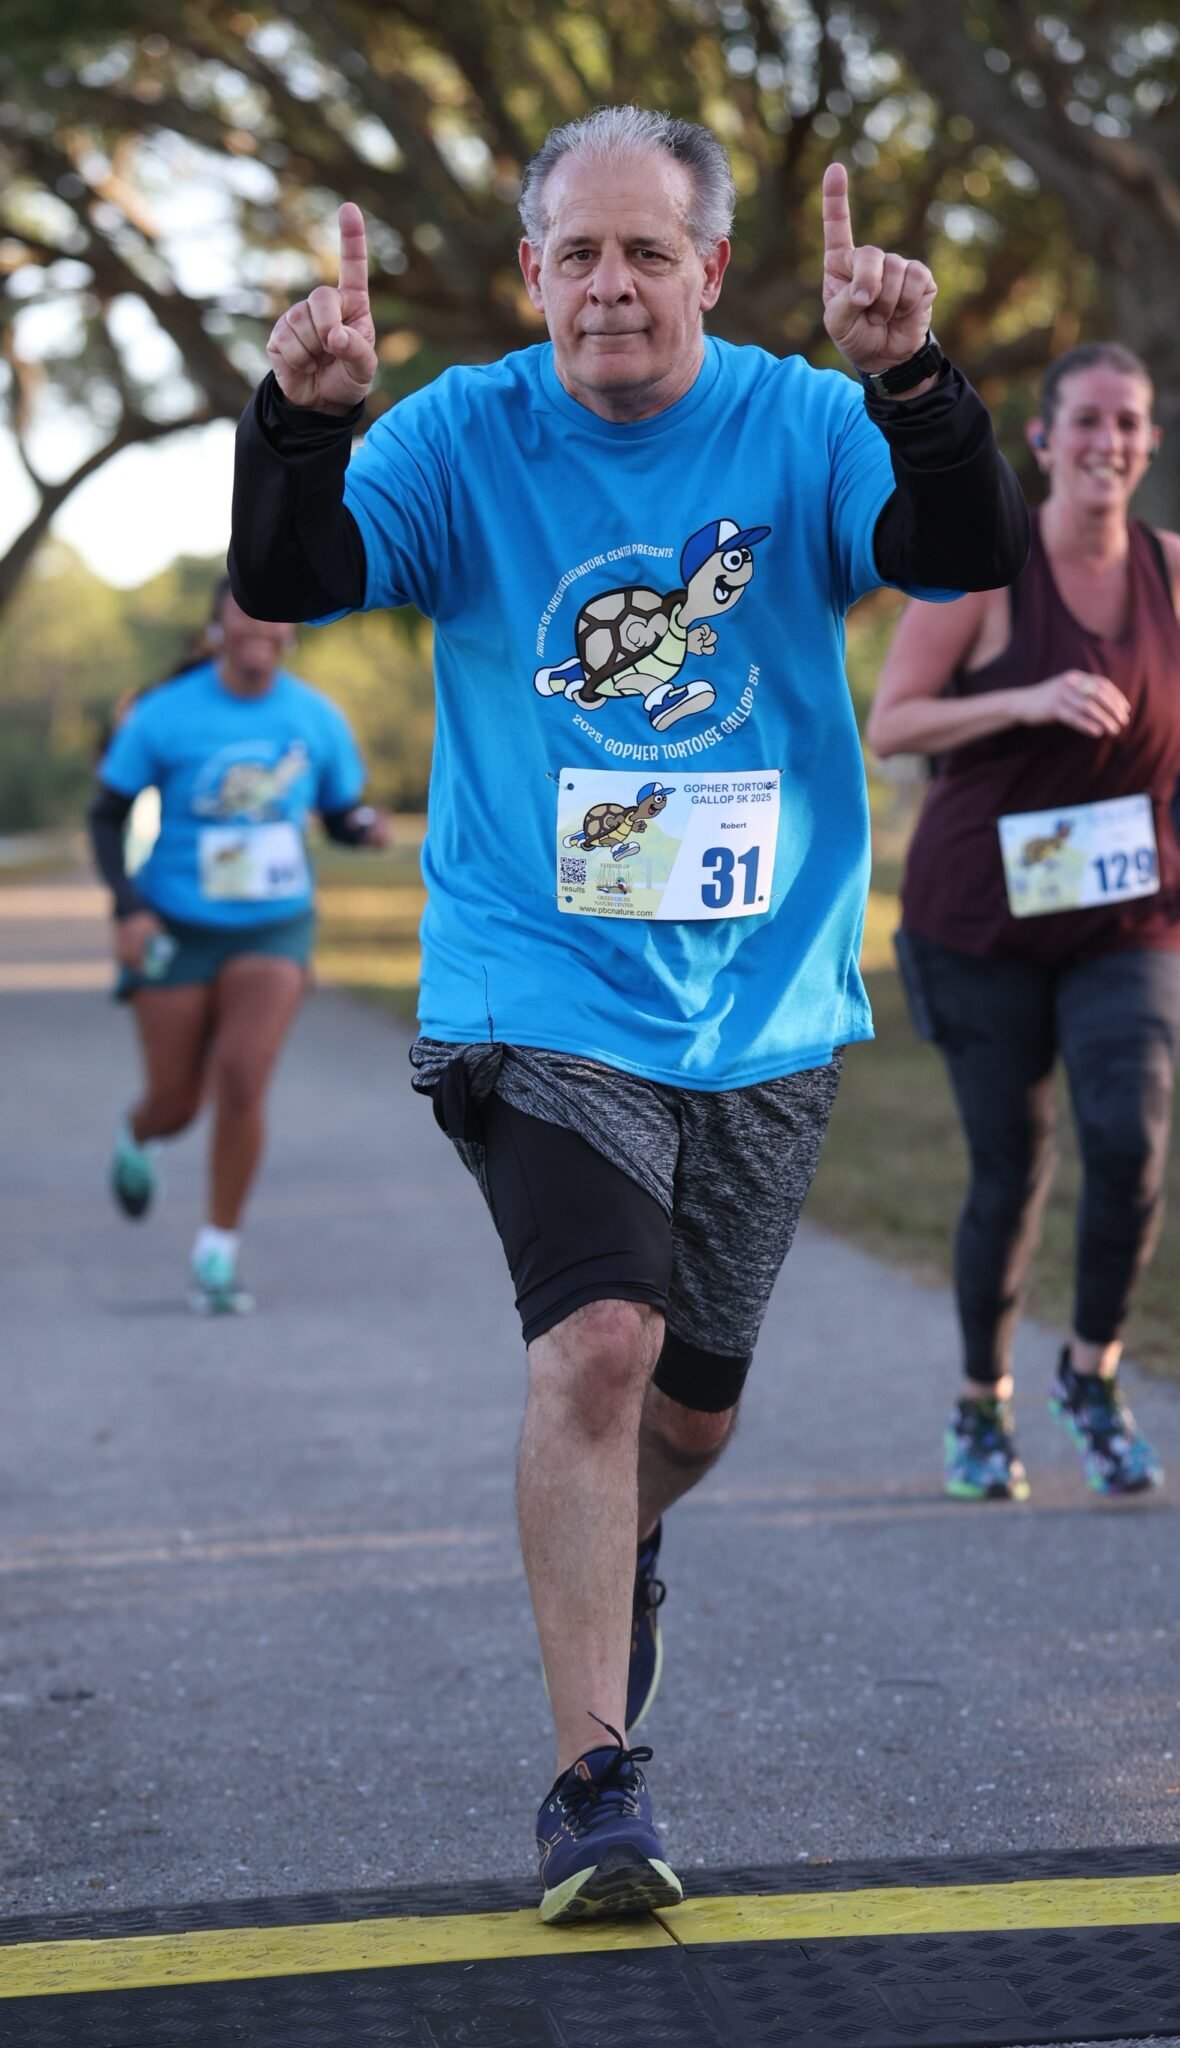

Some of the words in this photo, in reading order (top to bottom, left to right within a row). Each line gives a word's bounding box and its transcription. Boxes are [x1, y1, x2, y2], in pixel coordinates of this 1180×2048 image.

[632, 544, 674, 558] PRESENTS
[574, 554, 606, 578] NATURE
[541, 612, 552, 626] OF
[536, 623, 548, 658] FRIENDS
[572, 714, 602, 744] 2025
[604, 738, 658, 760] GOPHER
[661, 726, 724, 760] TORTOISE
[722, 687, 754, 734] GALLOP
[684, 783, 729, 793] GOPHER
[732, 780, 778, 792] TORTOIE
[691, 794, 734, 804] GALLOP
[736, 794, 748, 804] 5K
[751, 792, 772, 802] 2025
[702, 846, 760, 909] 31
[1094, 848, 1156, 892] 129
